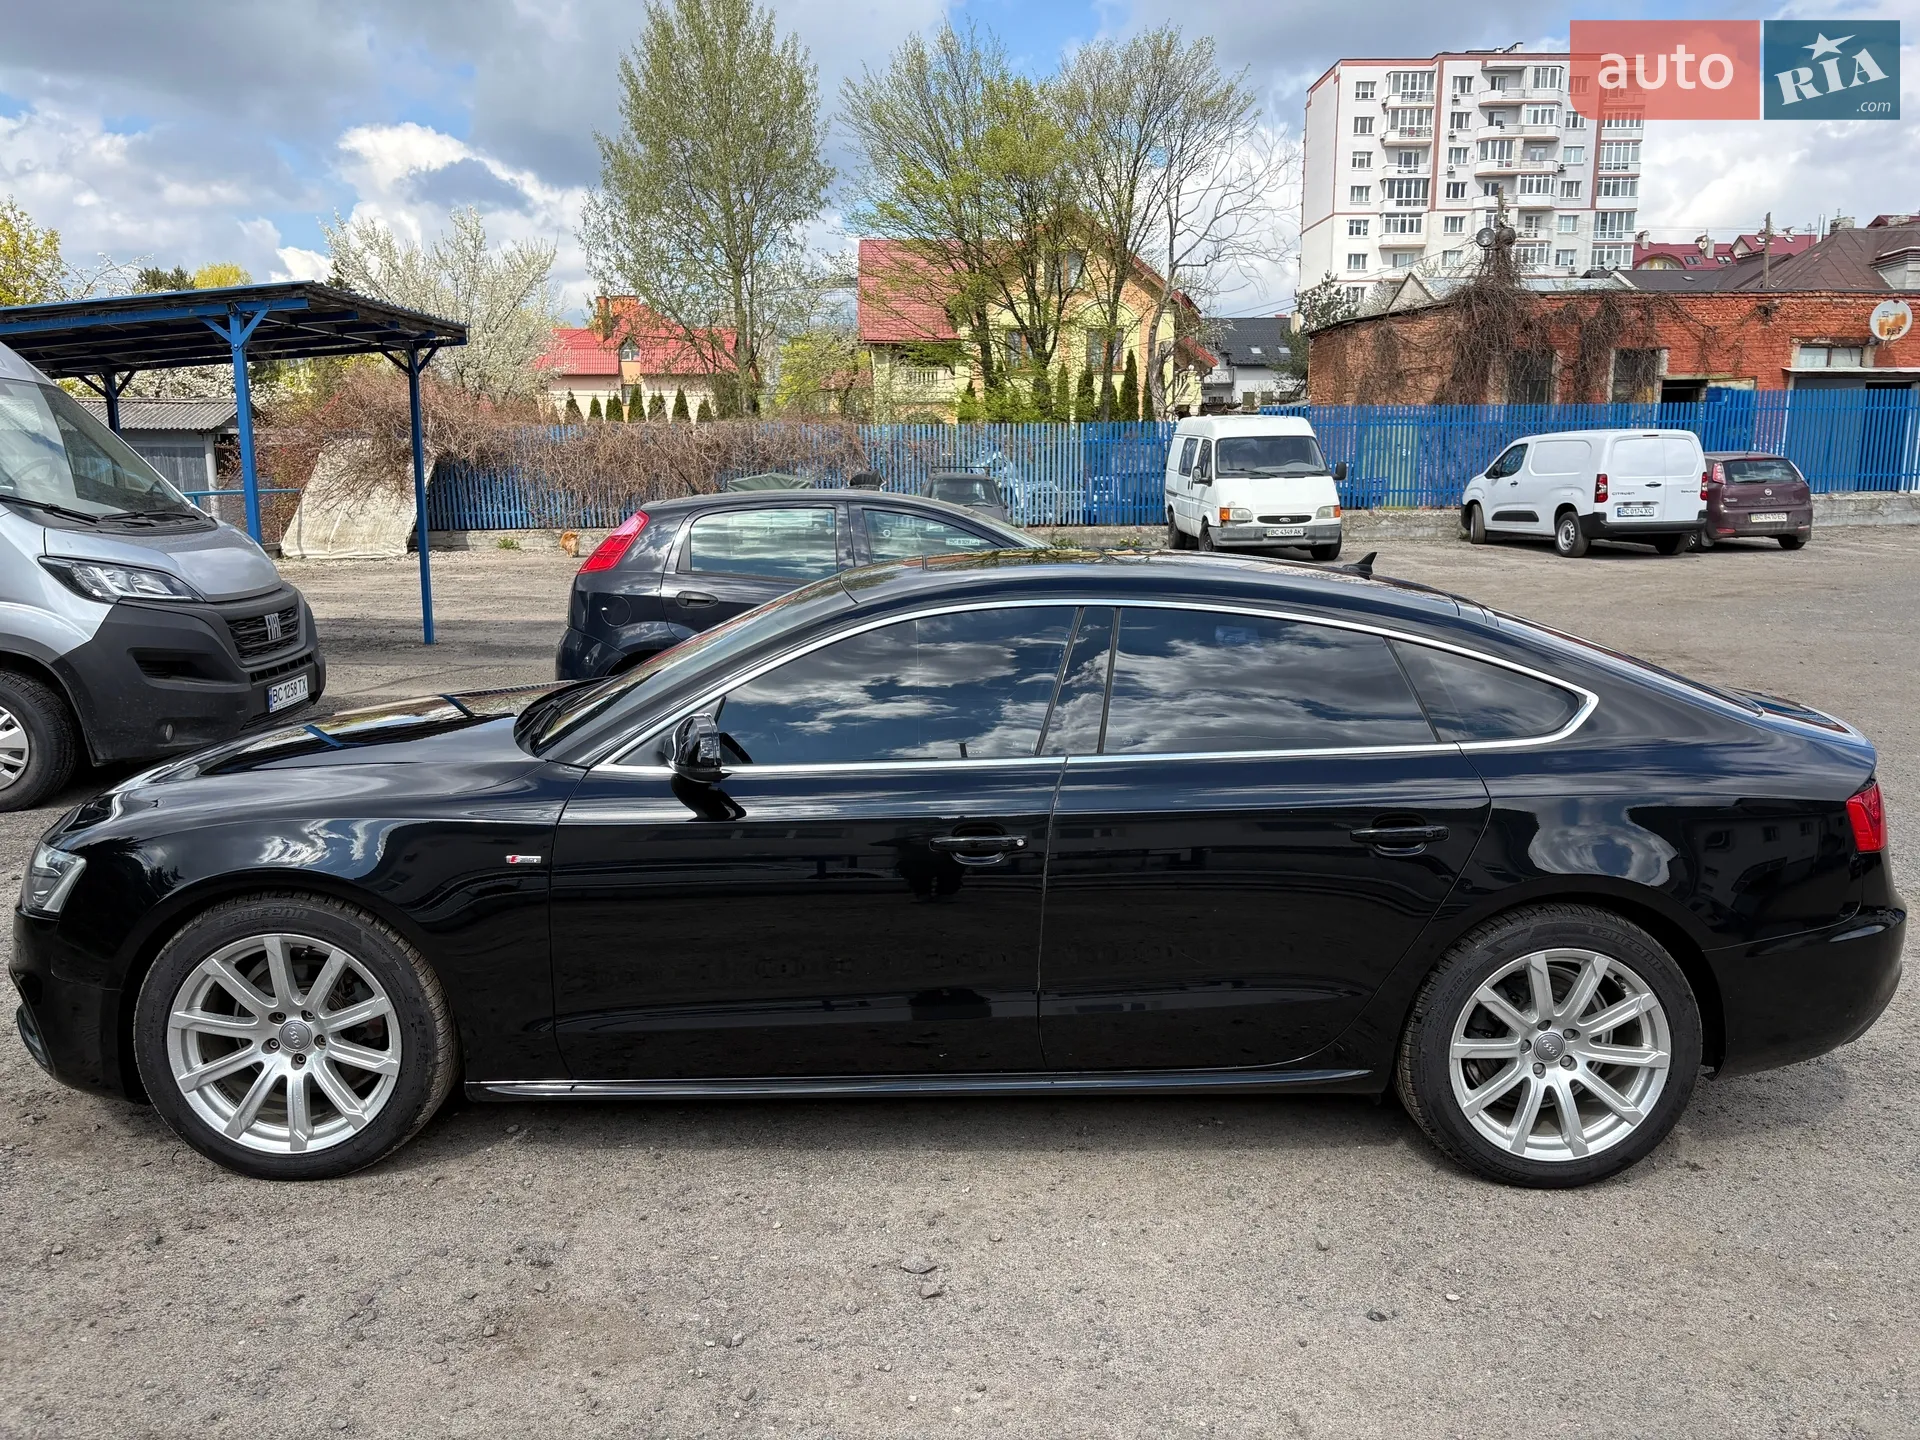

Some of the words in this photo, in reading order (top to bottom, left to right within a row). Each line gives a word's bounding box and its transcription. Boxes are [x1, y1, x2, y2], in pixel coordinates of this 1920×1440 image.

[264, 612, 282, 641] FIAT
[273, 688, 283, 703] BC
[284, 681, 298, 699] 1258
[298, 678, 307, 693] TX
